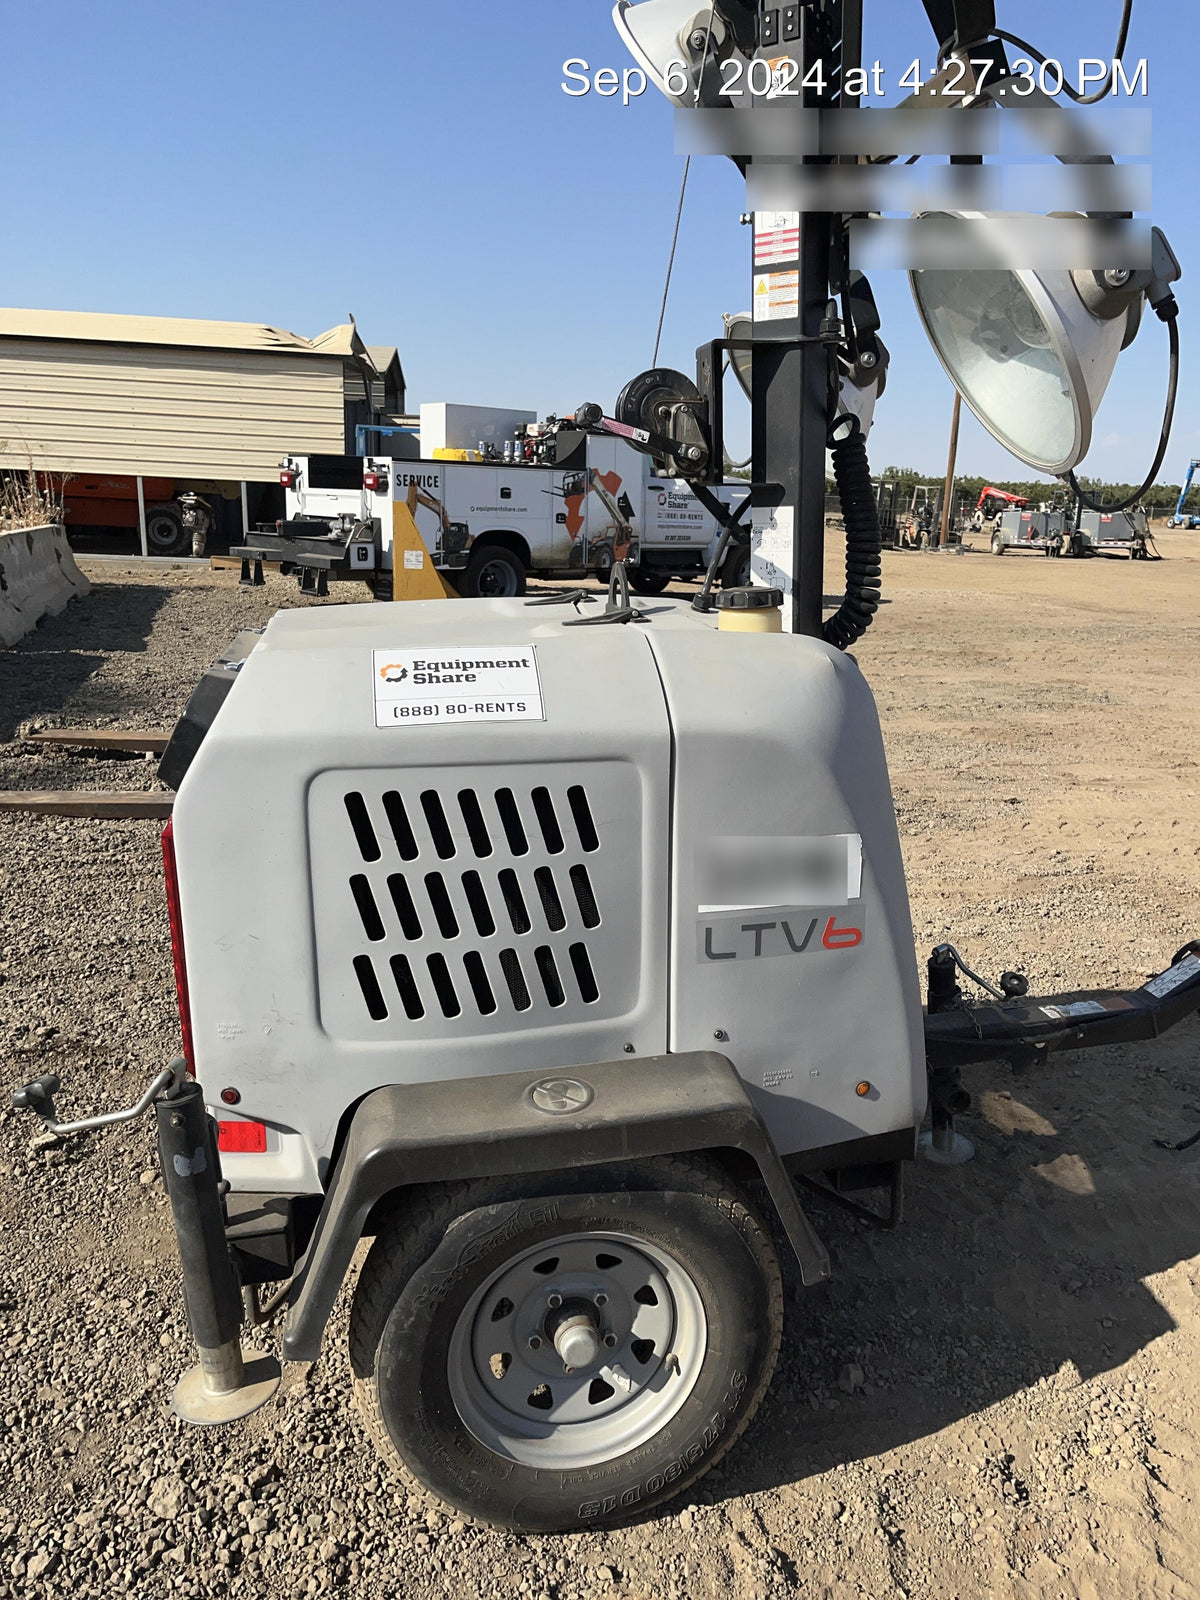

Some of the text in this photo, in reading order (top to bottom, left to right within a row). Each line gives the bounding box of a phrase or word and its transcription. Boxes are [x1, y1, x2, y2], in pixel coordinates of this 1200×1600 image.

[396, 474, 439, 488] SERVICE
[667, 500, 688, 509] Share
[412, 658, 530, 673] Equipment
[413, 672, 477, 685] Share
[393, 702, 526, 719] (888) 80-RENTS
[705, 916, 863, 960] LTV6
